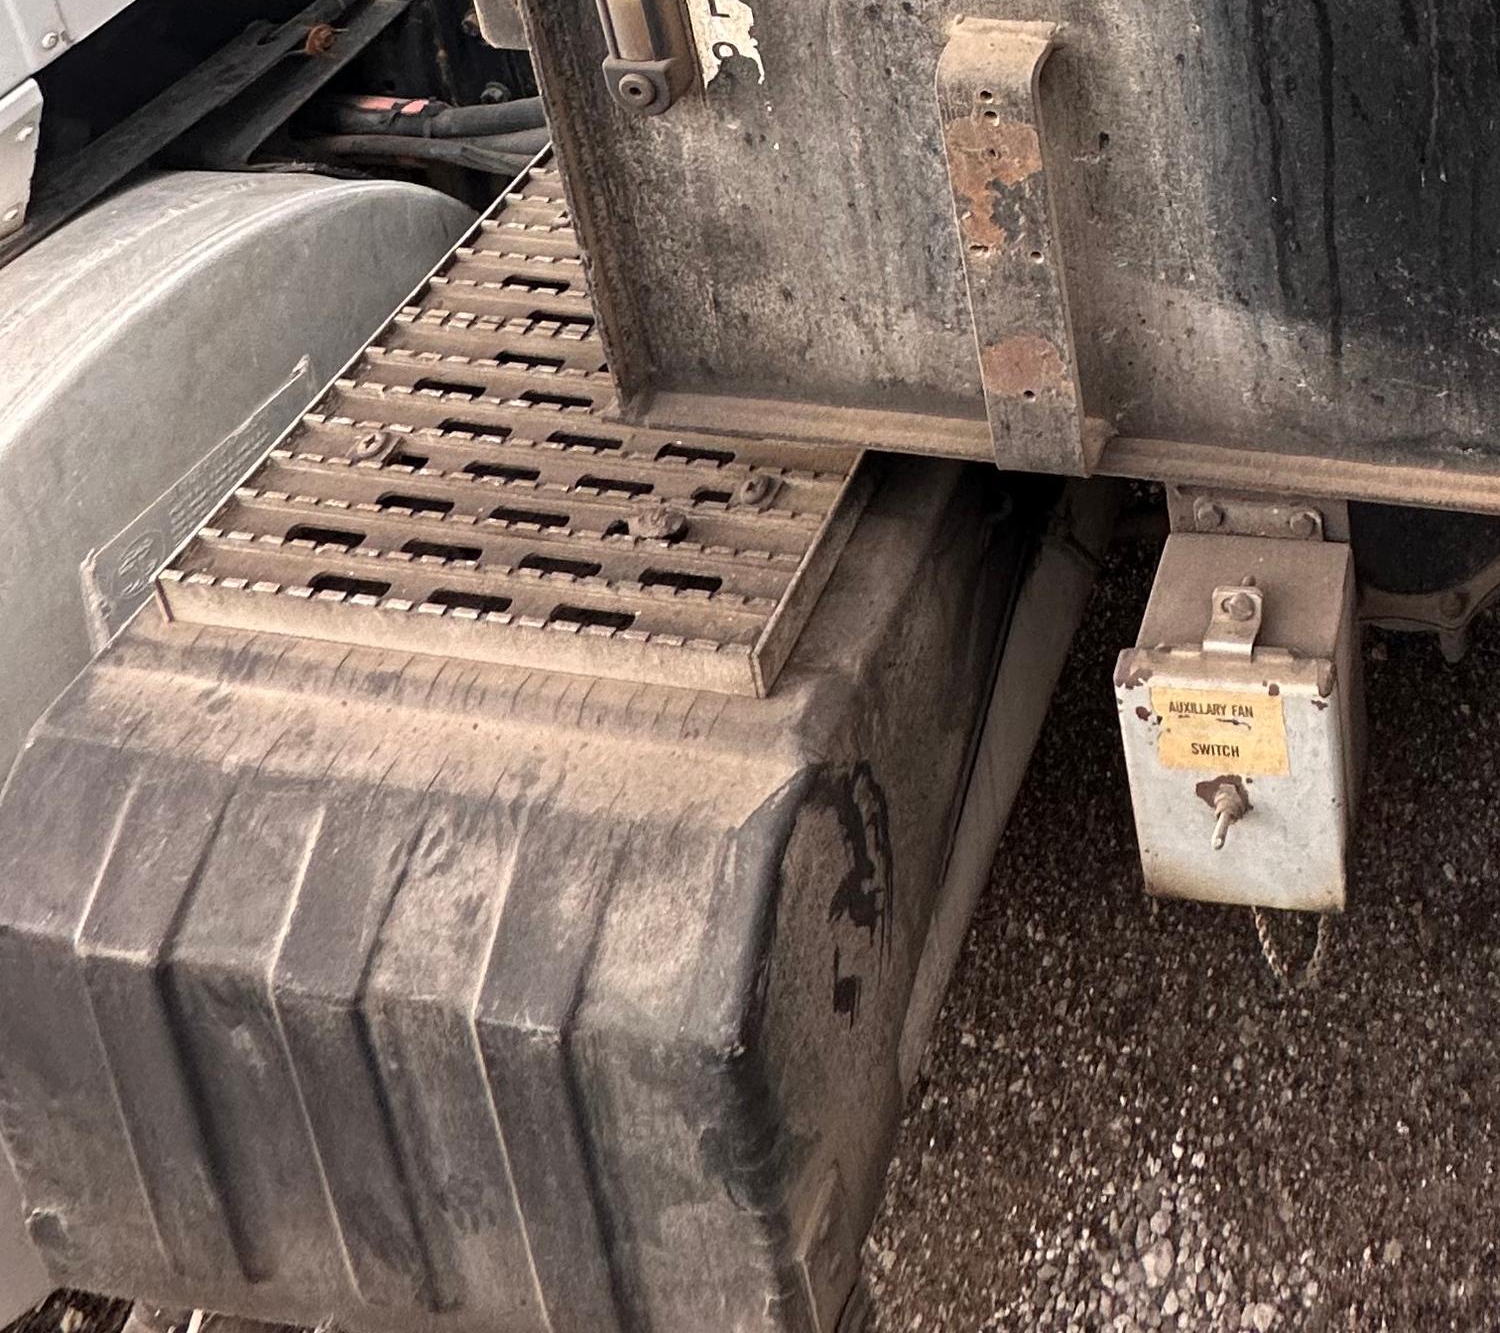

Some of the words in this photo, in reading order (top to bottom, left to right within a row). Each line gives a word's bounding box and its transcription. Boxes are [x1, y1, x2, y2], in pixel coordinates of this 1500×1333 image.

[1168, 701, 1227, 717] AUXILLARY
[1232, 704, 1254, 718] FAN
[1191, 742, 1240, 758] SWITCH
